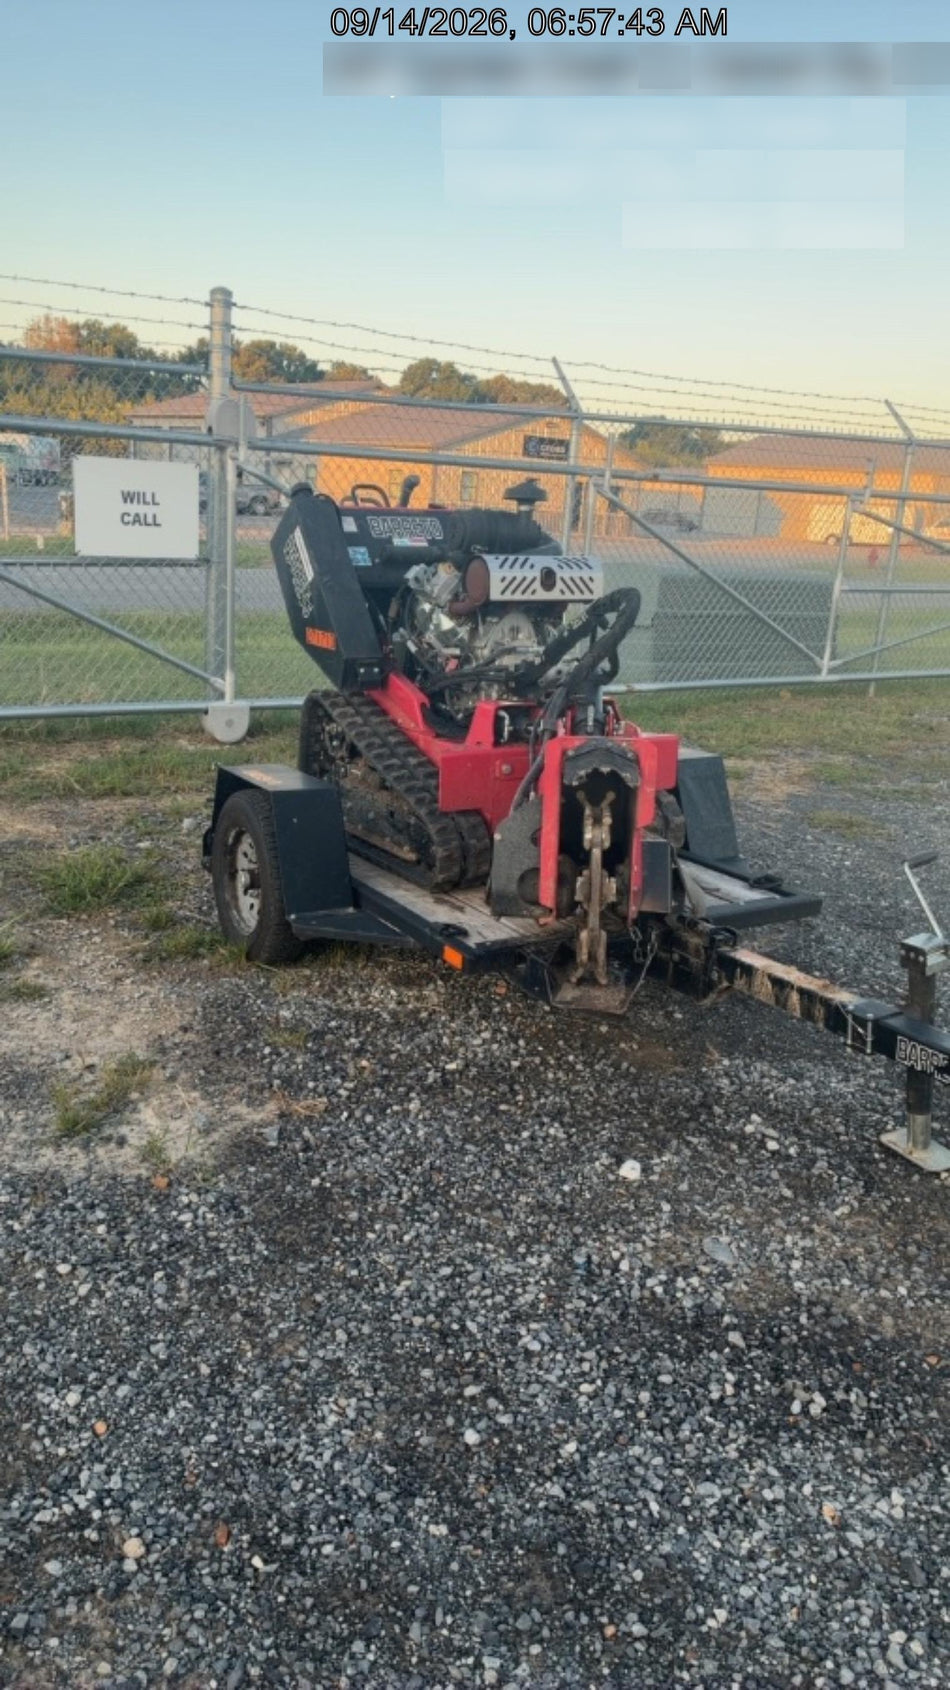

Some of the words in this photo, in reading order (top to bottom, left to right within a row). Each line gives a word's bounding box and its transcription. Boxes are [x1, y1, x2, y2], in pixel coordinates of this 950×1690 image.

[120, 489, 161, 506] WILL
[120, 511, 163, 527] CALL
[366, 515, 444, 540] BARRETO
